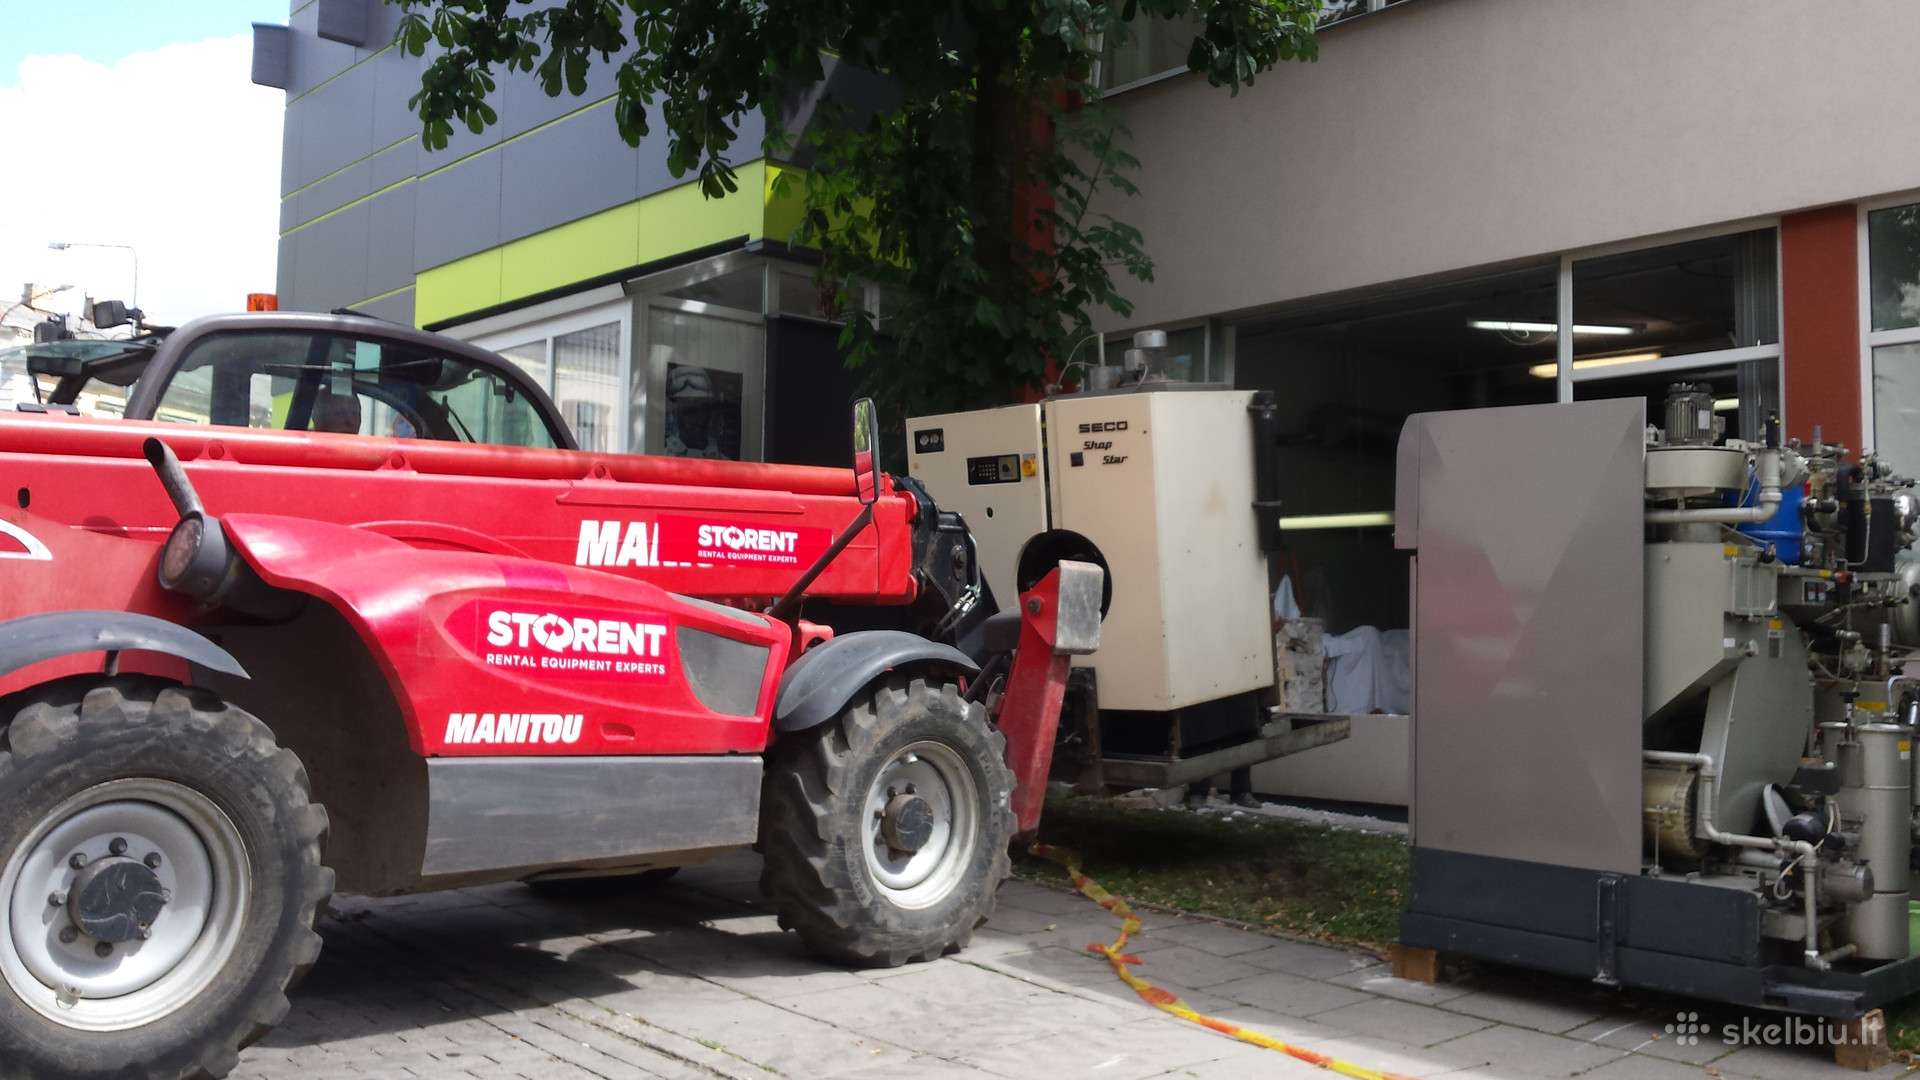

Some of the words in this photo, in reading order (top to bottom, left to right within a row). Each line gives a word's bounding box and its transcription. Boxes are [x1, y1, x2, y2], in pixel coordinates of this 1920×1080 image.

[1079, 421, 1128, 433] SECO
[1102, 455, 1128, 464] Star
[698, 525, 798, 552] STORENT
[698, 550, 726, 559] RENTAL
[727, 552, 766, 562] EQUIPMENT
[768, 554, 797, 564] EXPERTS
[487, 610, 667, 656] STORENT
[486, 653, 536, 667] RENTAL
[541, 656, 611, 671] EQUIPMENT
[616, 662, 666, 675] EXPERTS
[444, 713, 584, 744] MANITOU
